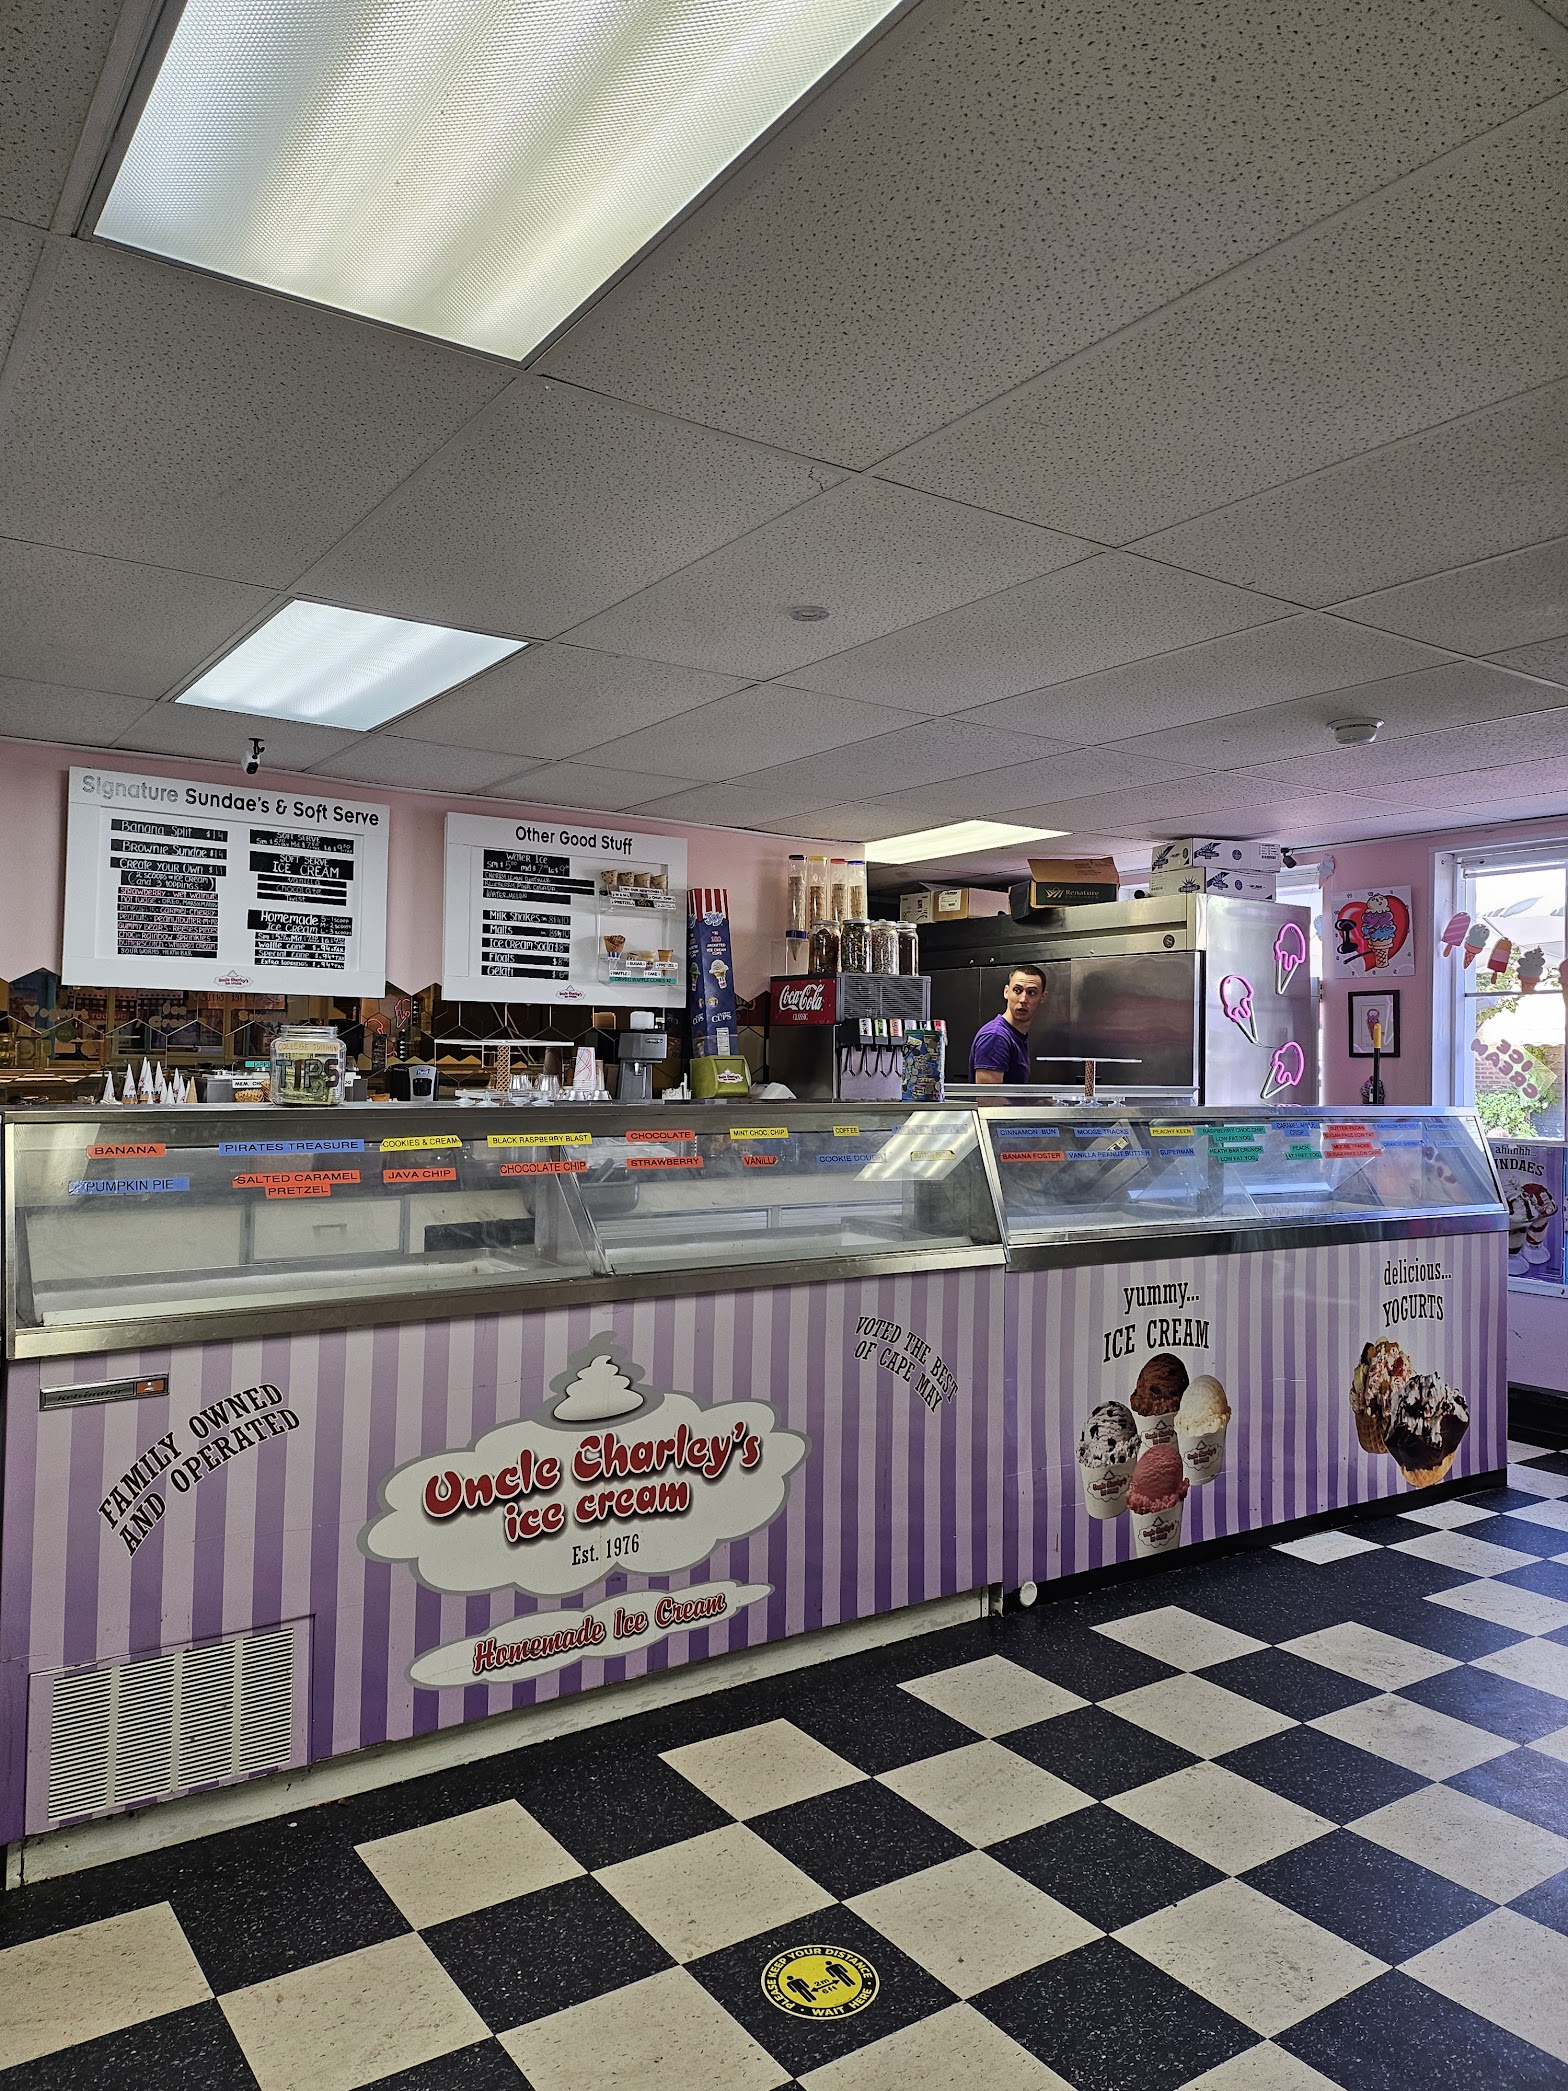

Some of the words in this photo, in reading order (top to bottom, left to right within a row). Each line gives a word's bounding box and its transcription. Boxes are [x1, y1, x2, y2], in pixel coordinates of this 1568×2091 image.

[82, 775, 178, 802] Signature
[186, 788, 269, 813] Sundae's
[276, 800, 287, 814] &
[294, 802, 327, 822] Soft
[334, 806, 379, 826] Serve
[122, 821, 164, 835] Banana
[171, 825, 192, 837] Split
[516, 826, 555, 844] Other
[560, 831, 596, 848] Good
[601, 836, 632, 855] Stuff
[123, 841, 169, 854] Brownie
[173, 843, 207, 858] Sundae
[120, 859, 152, 870] Create
[183, 864, 203, 874] Own
[280, 854, 299, 863] SOFT
[305, 857, 329, 866] SERVE
[535, 855, 548, 864] Ice
[273, 861, 291, 873] ICE
[300, 865, 339, 878] CREAM
[260, 910, 319, 926] Homemade
[490, 911, 507, 920] Milk
[510, 912, 540, 922] Shakes
[267, 922, 281, 930] Ice
[285, 924, 318, 934] Cream
[490, 924, 513, 934] Malts
[490, 938, 504, 947] Ice
[505, 939, 533, 949] Cream
[534, 941, 554, 951] Soda
[489, 953, 515, 962] Floats
[487, 966, 514, 976] Gelati
[712, 1014, 732, 1022] CUPS
[276, 1059, 339, 1089] TIPS
[383, 1139, 419, 1148] COOKIES
[429, 1137, 458, 1146] CREAM
[492, 1136, 518, 1144] BLACK
[520, 1136, 563, 1144] RASPBERRY
[630, 1131, 690, 1140] CHOCOLATE
[95, 1146, 157, 1154] BANANA
[225, 1143, 283, 1152] PIRATES
[288, 1140, 358, 1150] TREASURE
[500, 1163, 561, 1174] CHOCOLATE
[564, 1162, 586, 1171] CHIP
[631, 1158, 699, 1166] STRAWBERRY
[237, 1175, 290, 1184] SALTED
[293, 1172, 357, 1182] CARAMEL
[389, 1170, 418, 1178] JAVA
[423, 1169, 451, 1178] CHIP
[86, 1180, 150, 1192] PUMPKIN
[153, 1180, 173, 1189] PIE
[268, 1186, 328, 1196] PRETZEL
[1384, 1258, 1452, 1285] delicious...
[1124, 1282, 1200, 1314] yummy...
[1383, 1293, 1443, 1327] YOGURTS
[1103, 1324, 1136, 1363] ICE
[1146, 1318, 1210, 1349] CREAM
[856, 1317, 902, 1343] VOTED
[904, 1332, 931, 1365] THE
[930, 1356, 958, 1402] BEST
[854, 1340, 877, 1360] OF
[879, 1348, 916, 1382] CAPE
[915, 1372, 942, 1413] MAY
[57, 1387, 124, 1402] Kelvinator
[99, 1432, 182, 1530] FAMILY
[189, 1384, 284, 1439] OWNED
[424, 1448, 560, 1517] Uncle
[572, 1421, 761, 1482] Charley's
[119, 1492, 166, 1556] AND
[170, 1409, 300, 1493] OPERATED
[505, 1500, 564, 1542] ice
[575, 1478, 690, 1524] cream
[571, 1544, 598, 1566] Est.
[606, 1534, 639, 1558] 1976
[473, 1616, 606, 1675] Homemade
[613, 1609, 648, 1638] Ice
[654, 1592, 727, 1628] Cream
[787, 1948, 822, 1960] YOUR
[768, 1958, 786, 1978] KEEP
[825, 1948, 872, 1979] DISTANCE
[767, 1979, 795, 2009] PLEASE
[822, 1985, 837, 1994] 6ft
[812, 2007, 844, 2016] WAIT
[849, 1987, 872, 2008] HERE
